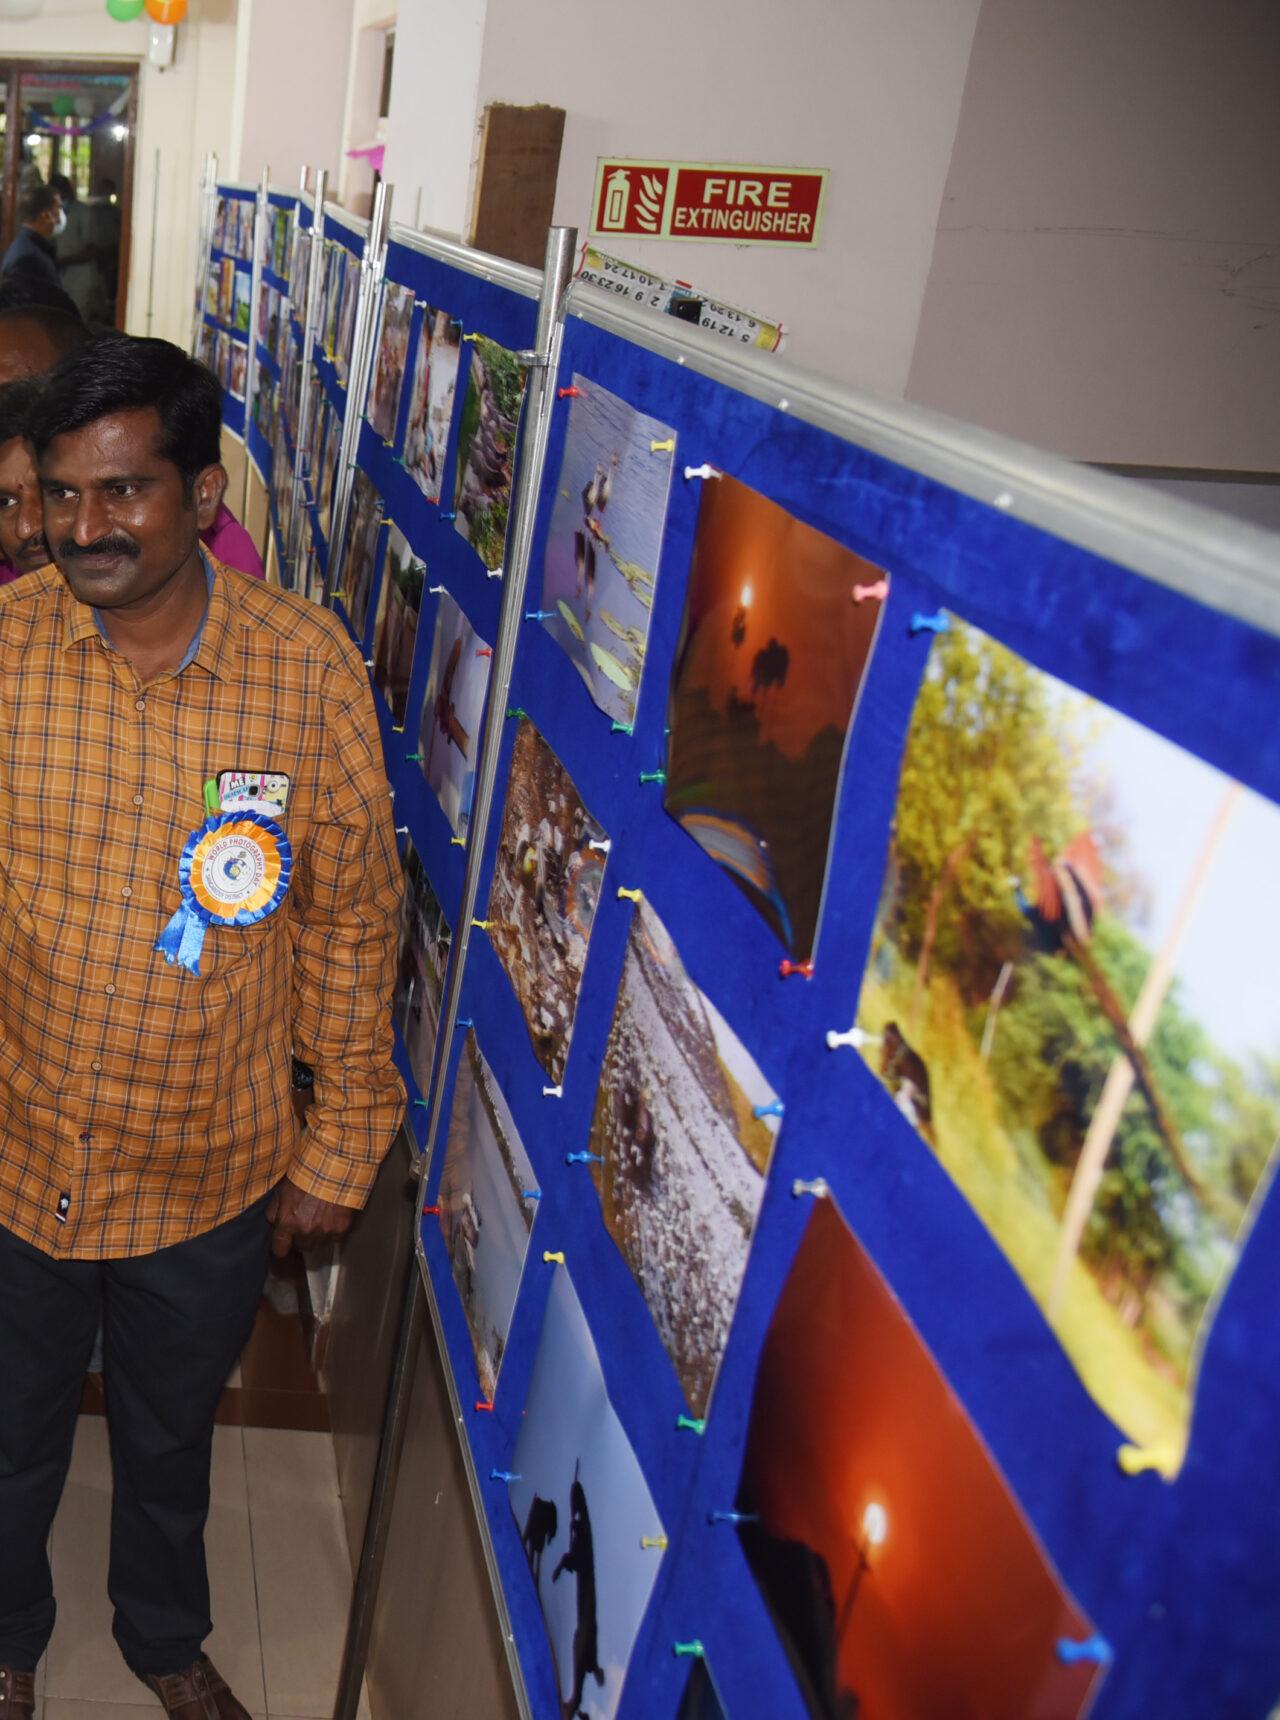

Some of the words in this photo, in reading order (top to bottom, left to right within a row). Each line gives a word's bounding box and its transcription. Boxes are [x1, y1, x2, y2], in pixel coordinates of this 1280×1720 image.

[703, 178, 793, 208] FIRE
[674, 207, 812, 235] EXTINGUISHER
[604, 261, 619, 274] 24
[580, 270, 598, 283] 30
[621, 268, 636, 281] 17
[639, 275, 654, 287] 10
[598, 277, 614, 290] 23
[614, 284, 630, 296] 16
[634, 291, 644, 302] 9
[650, 296, 661, 307] 2
[701, 317, 717, 331] 19
[719, 324, 735, 338] 12
[740, 334, 751, 344] 5
[208, 841, 228, 861] WORLD
[253, 873, 262, 886] DAY
